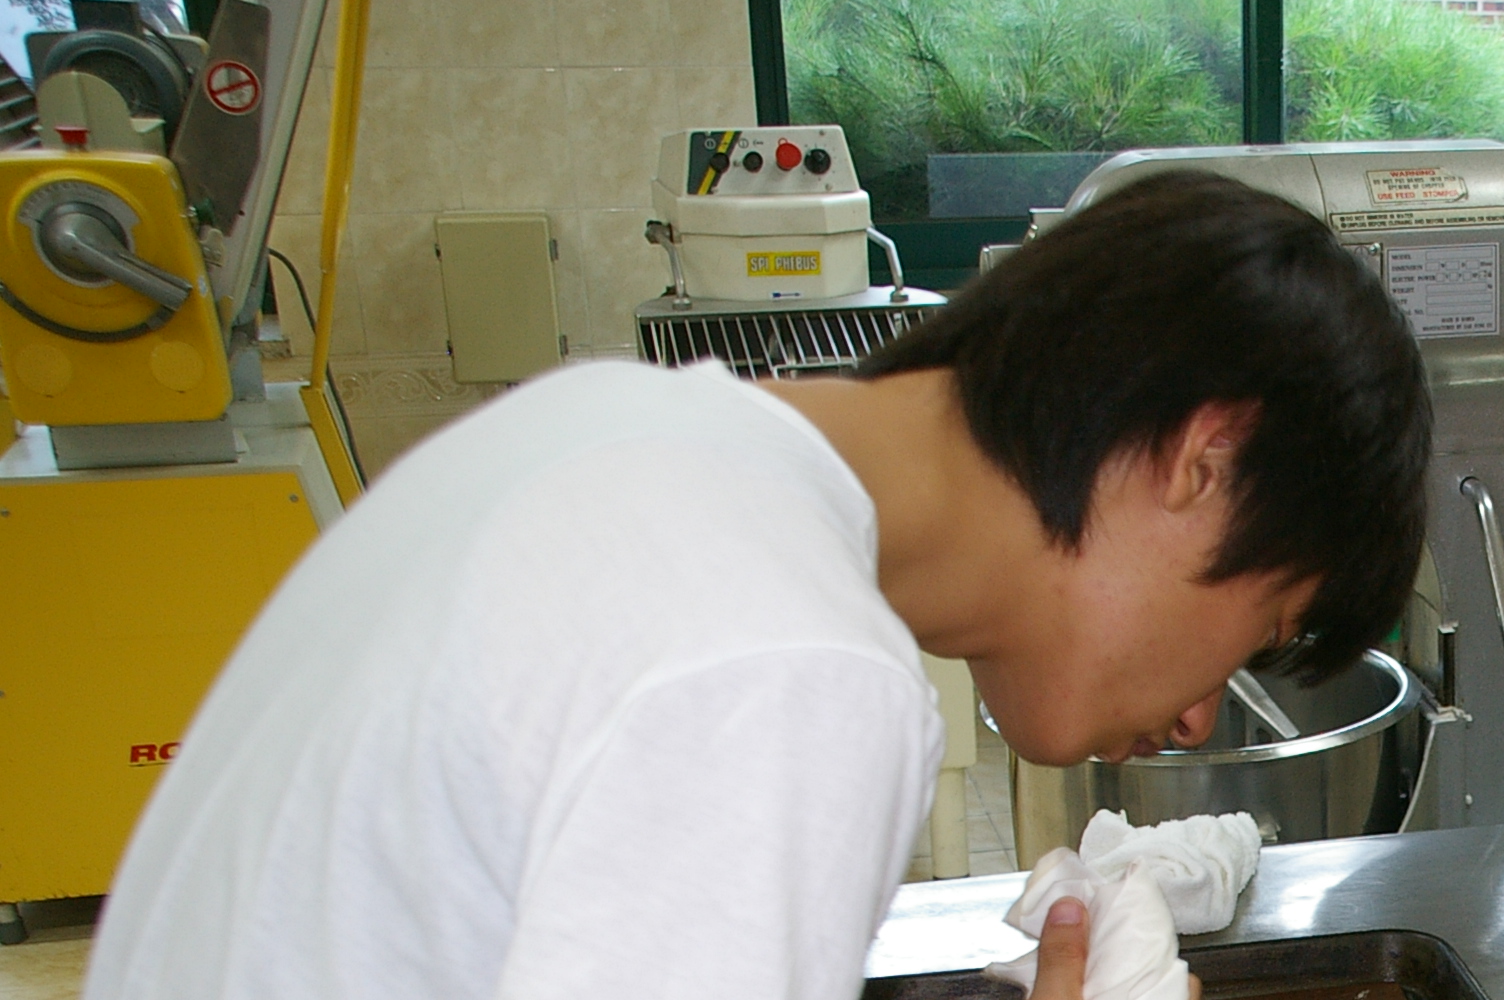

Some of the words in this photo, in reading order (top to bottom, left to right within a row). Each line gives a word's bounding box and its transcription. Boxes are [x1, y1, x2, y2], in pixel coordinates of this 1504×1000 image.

[1389, 169, 1436, 177] WARNING
[1377, 192, 1393, 200] USE
[1395, 191, 1415, 199] FEED
